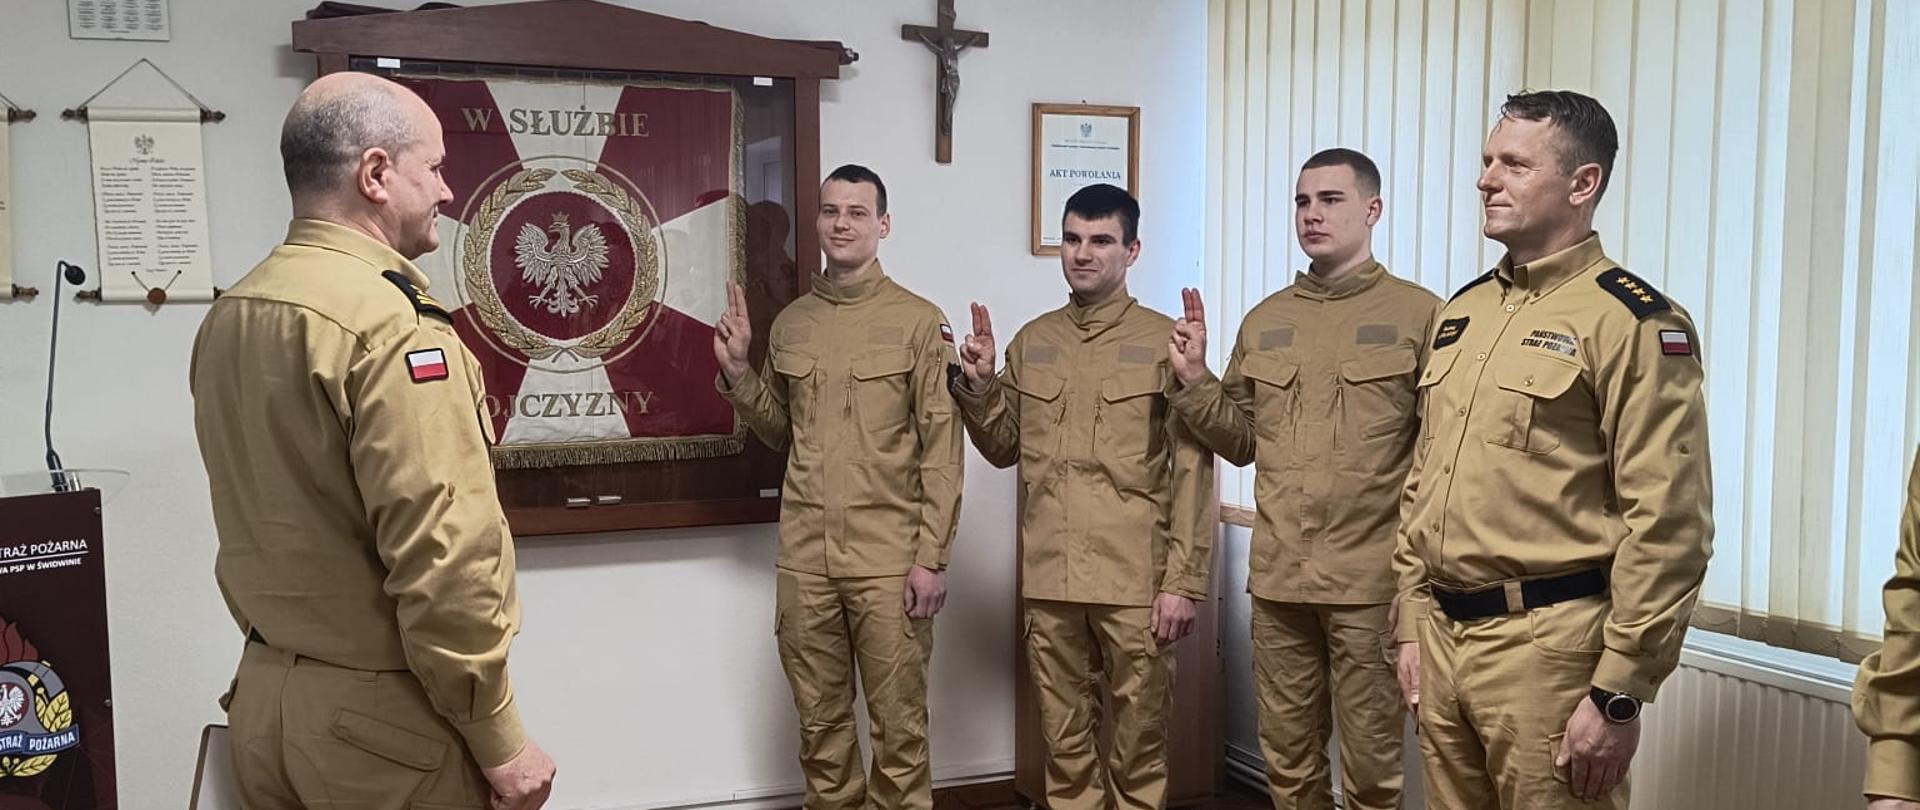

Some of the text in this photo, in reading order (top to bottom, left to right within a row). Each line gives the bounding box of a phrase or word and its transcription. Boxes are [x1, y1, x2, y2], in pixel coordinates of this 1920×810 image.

[461, 105, 650, 138] W SŁUŻBIE
[1050, 169, 1067, 178] AKT
[485, 391, 654, 418] OJCZYZNY
[30, 539, 87, 555] POŻARNA
[10, 565, 25, 573] PSP
[26, 563, 36, 571] W
[29, 732, 75, 751] POŻARNA
